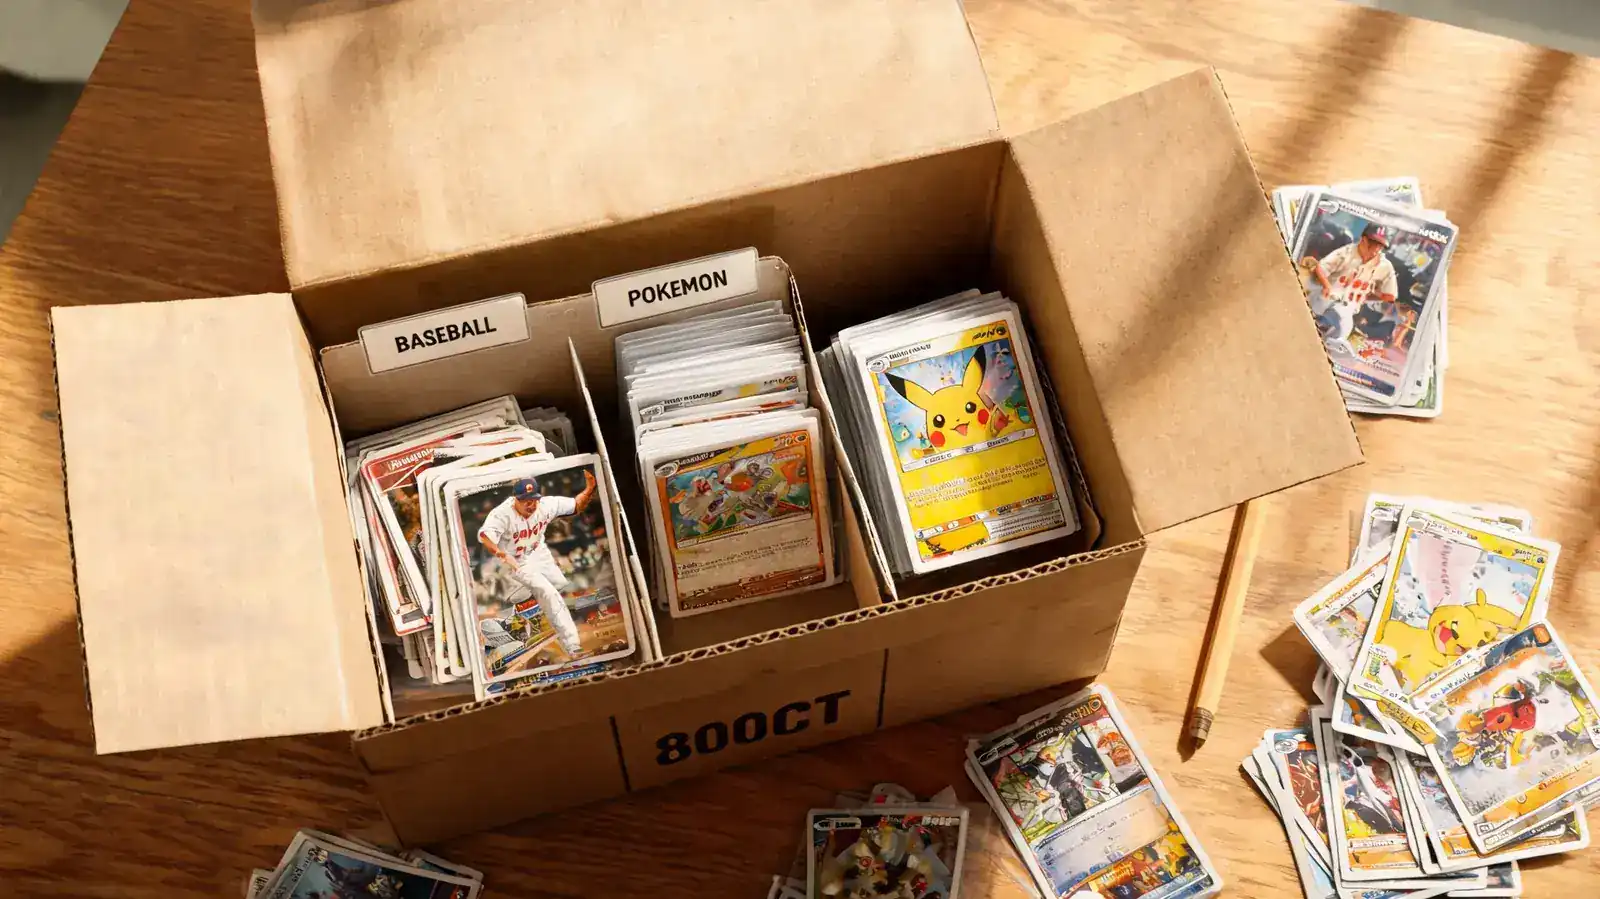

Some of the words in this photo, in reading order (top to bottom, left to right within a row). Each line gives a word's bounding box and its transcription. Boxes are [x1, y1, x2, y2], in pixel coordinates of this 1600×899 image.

[628, 270, 728, 306] POKEMON
[395, 318, 496, 353] BASEBALL
[656, 690, 850, 765] 800CT
